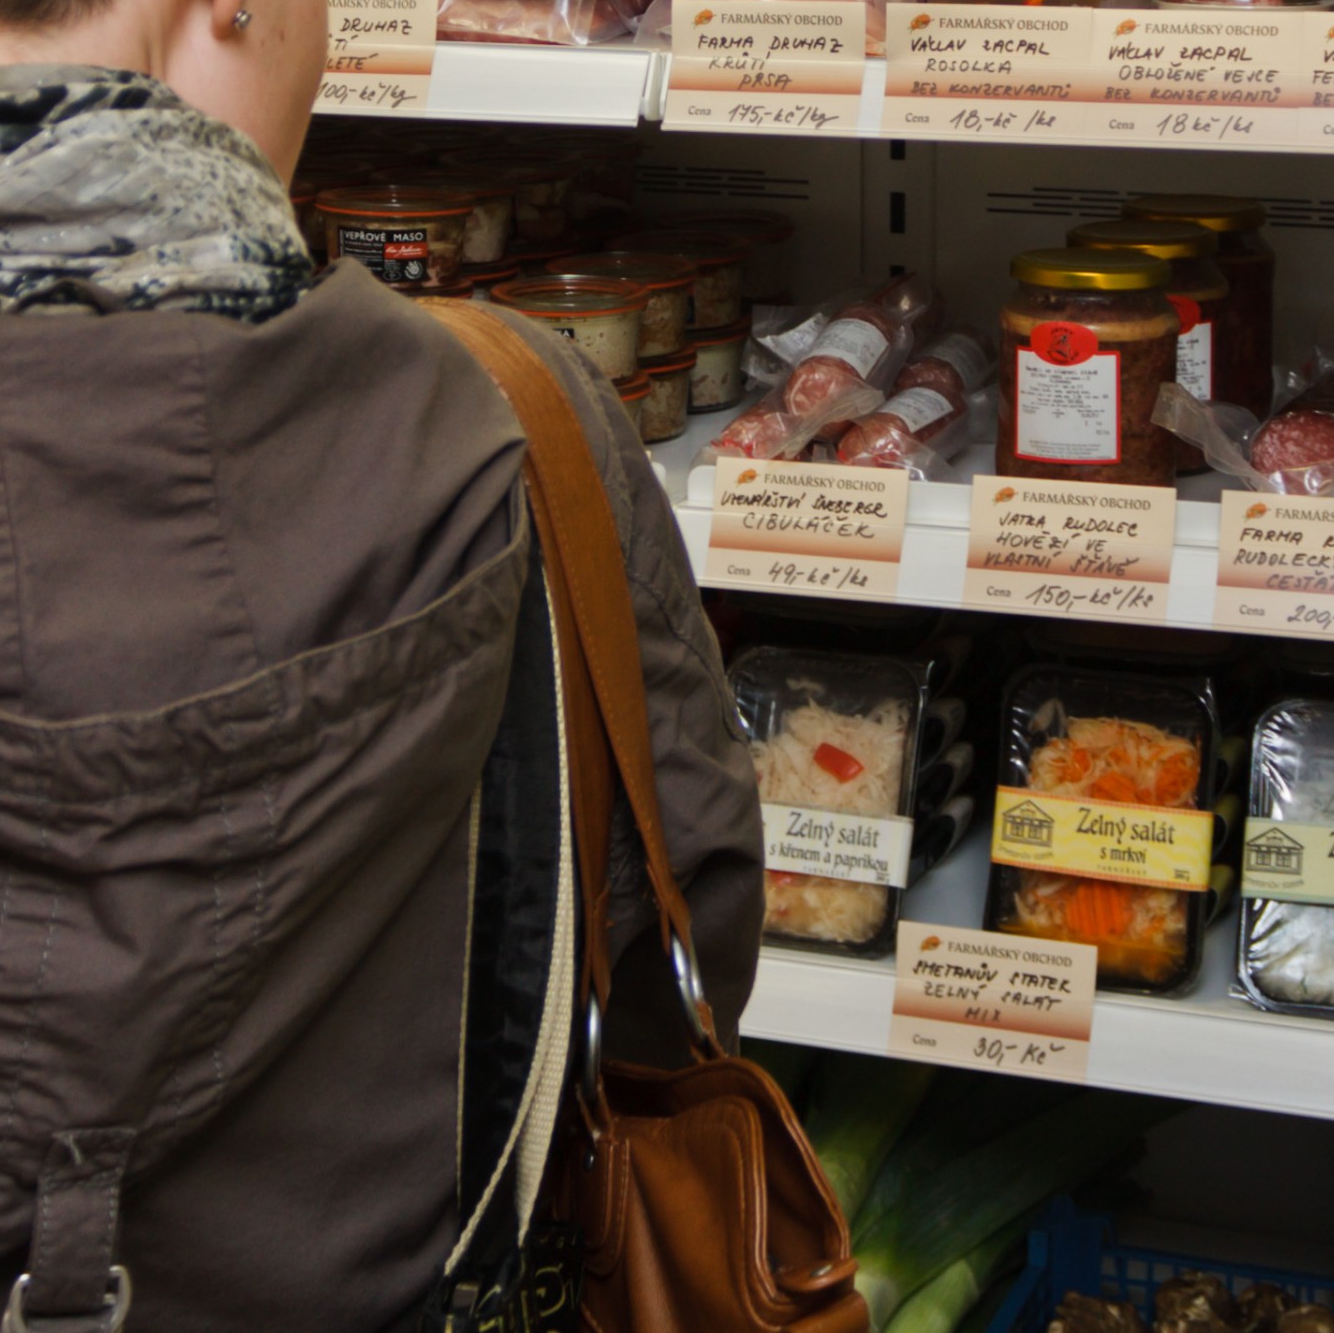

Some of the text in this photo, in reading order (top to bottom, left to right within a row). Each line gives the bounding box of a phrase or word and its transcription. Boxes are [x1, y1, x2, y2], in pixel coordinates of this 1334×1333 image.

[372, 0, 416, 9] OBCHOD
[721, 13, 843, 26] FARMÁŘSKÝ OBCHOD
[939, 17, 1069, 31] FARMÁŘSKÝ OBCHOD
[1145, 22, 1279, 37] FARMÁŘSKÝ OBCHOD
[698, 34, 753, 50] FARMA
[1180, 46, 1253, 61] ZACPAL
[925, 58, 1013, 74] ROSOLKA
[738, 72, 792, 91] PRSA
[1224, 69, 1279, 83] VEJCE
[911, 81, 937, 96] BEZ
[1104, 86, 1131, 101] BEZ
[688, 106, 712, 116] Cena
[905, 113, 930, 123] Cena
[1109, 119, 1135, 130] Cena
[345, 230, 424, 242] VEPŘOVÉ MASO
[764, 472, 885, 493] FARMÁŘSKÝ OBCHOD
[1022, 490, 1151, 511] FARMÁŘSKÝ OBCHOD
[1062, 516, 1138, 537] RUDOLEC
[1239, 527, 1303, 545] FARMA
[1085, 539, 1108, 553] VE
[727, 564, 751, 577] Cena
[986, 585, 1011, 598] Cena
[1239, 604, 1265, 617] Cena
[786, 811, 881, 848] Zelný salát
[1076, 806, 1176, 845] Zelný salát
[769, 844, 776, 856] s
[778, 842, 821, 863] křenem
[823, 855, 831, 863] a
[834, 854, 889, 875] paprikou
[1100, 847, 1148, 865] s mrkví
[948, 942, 1072, 967] FARMÁŘSKÝ OBCHOD
[965, 1007, 1002, 1022] MIX
[912, 1034, 937, 1047] Cena
